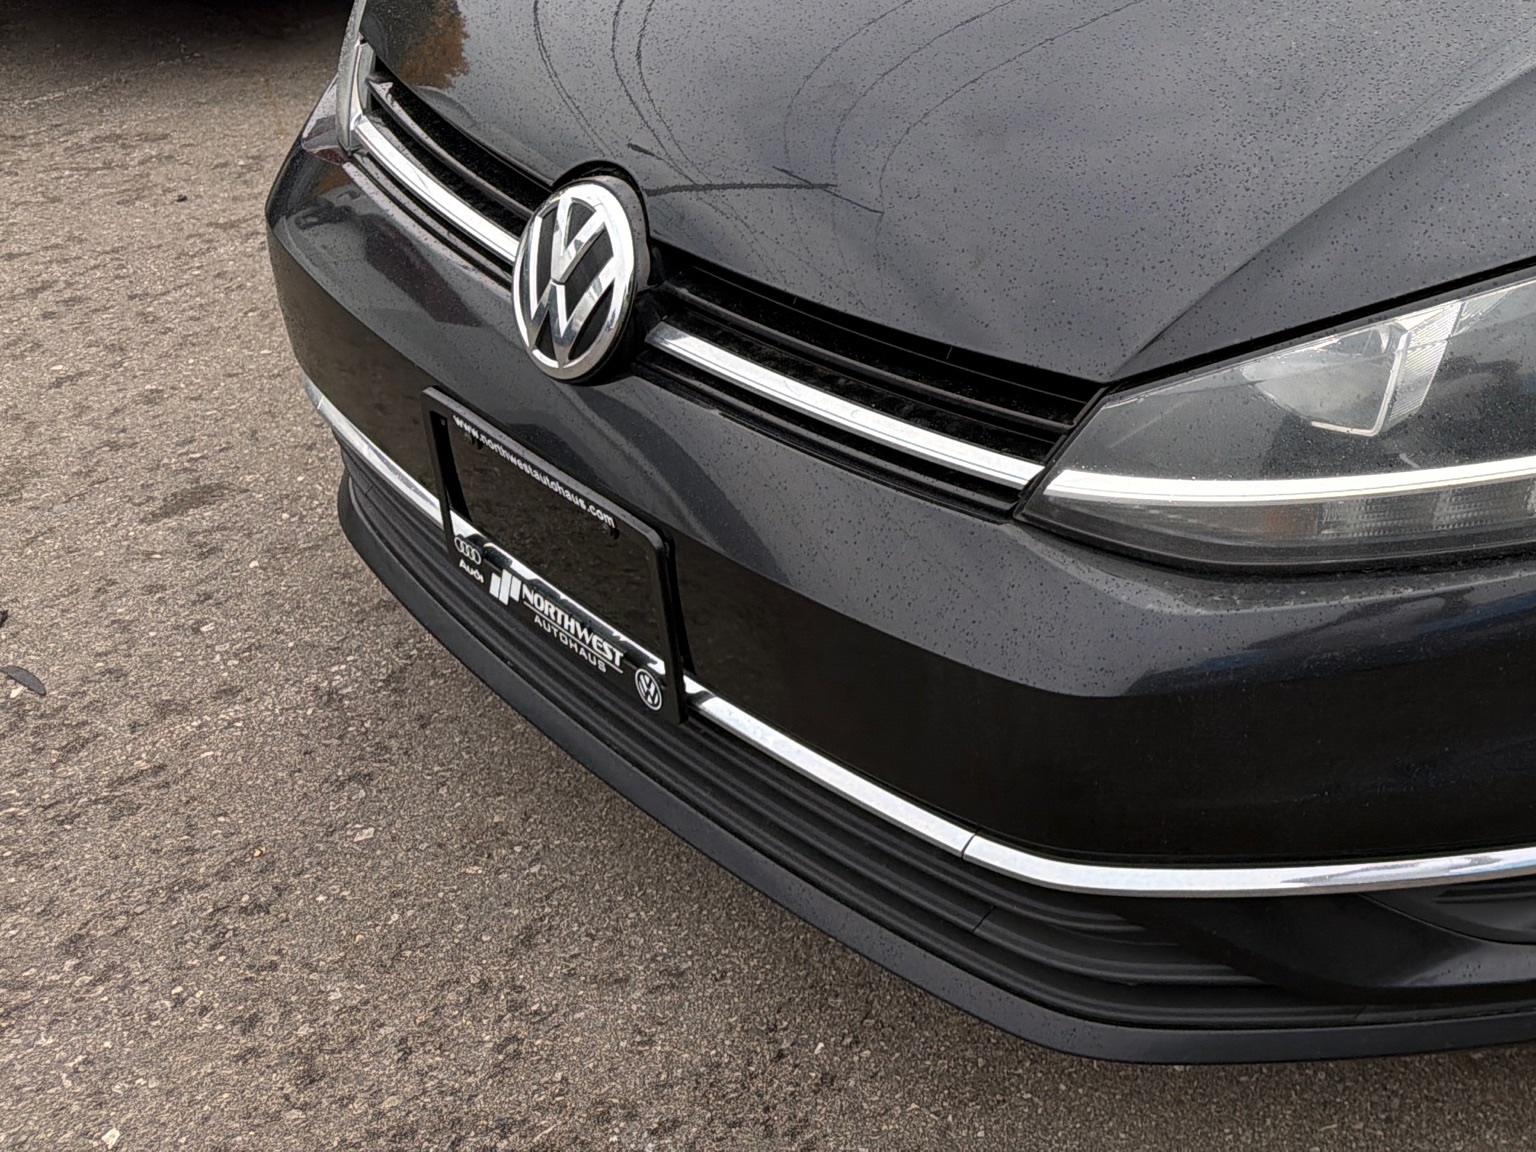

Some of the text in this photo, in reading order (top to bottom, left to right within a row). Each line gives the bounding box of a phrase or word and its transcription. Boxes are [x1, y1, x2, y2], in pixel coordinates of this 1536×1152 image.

[453, 414, 616, 529] www.northwestautohaus.com
[522, 583, 624, 667] NORTHWEST
[534, 614, 607, 673] AUTOHAUS
